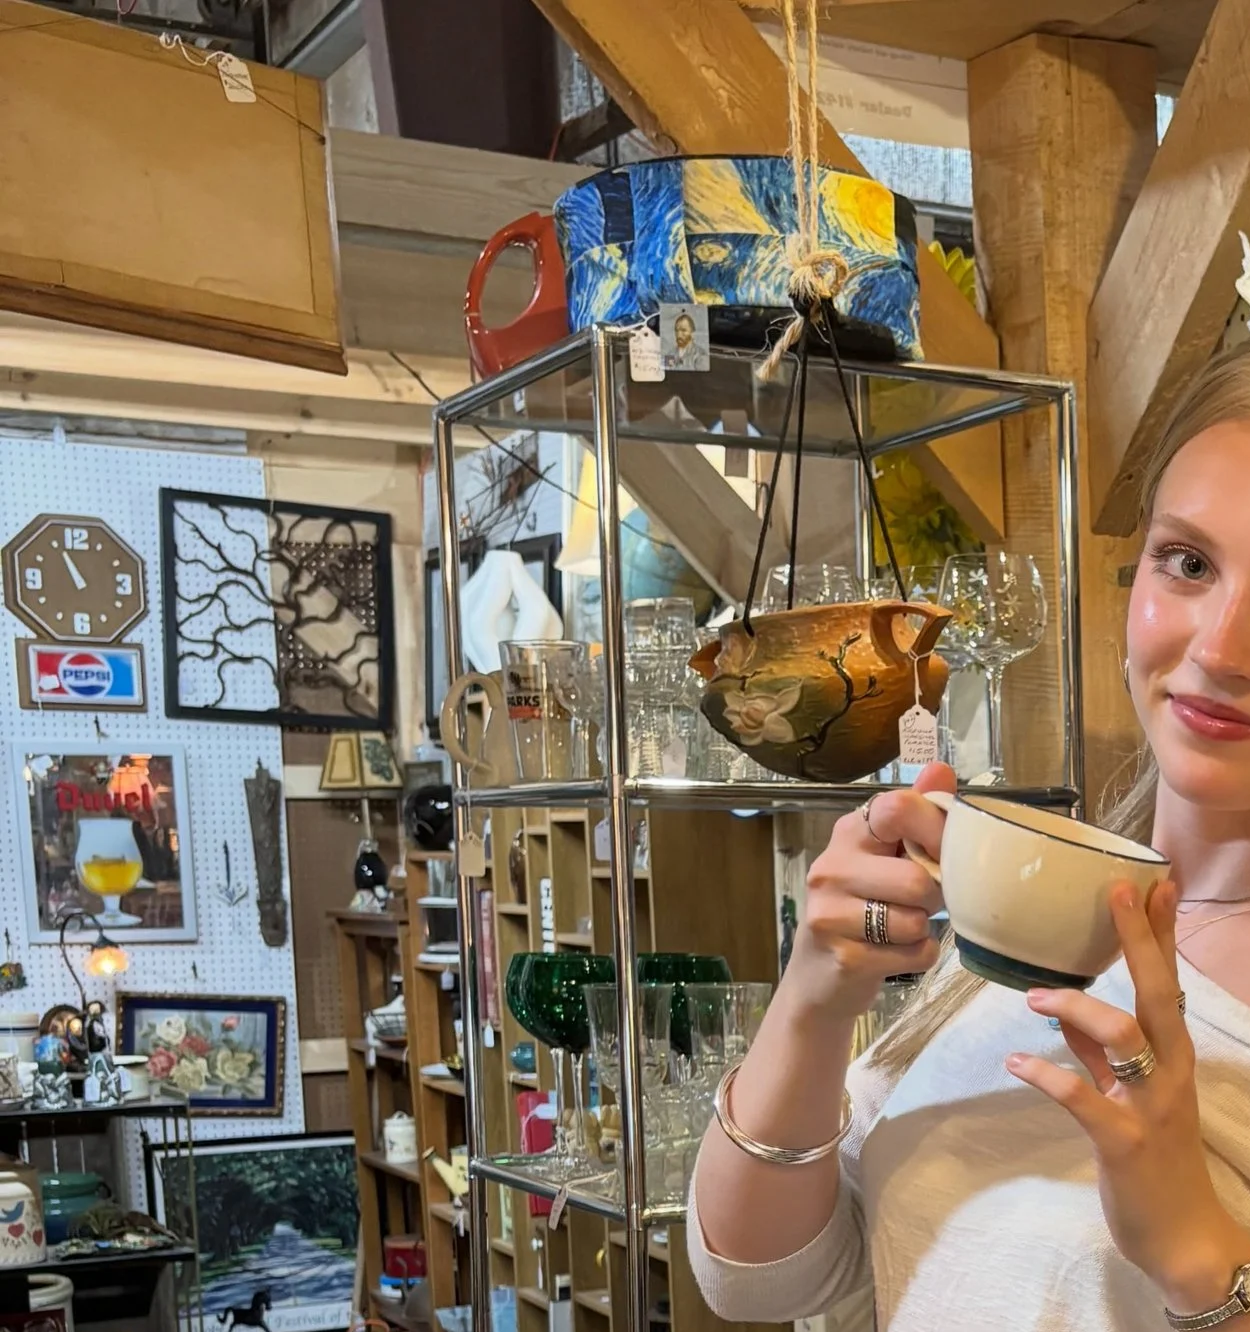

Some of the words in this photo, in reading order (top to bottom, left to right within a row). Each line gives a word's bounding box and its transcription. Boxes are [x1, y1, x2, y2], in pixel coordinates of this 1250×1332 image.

[64, 527, 89, 551] 12
[25, 568, 42, 590] 9
[116, 573, 132, 596] 3
[73, 612, 91, 635] 6
[62, 669, 112, 683] PEPSI
[55, 781, 154, 814] Duvel
